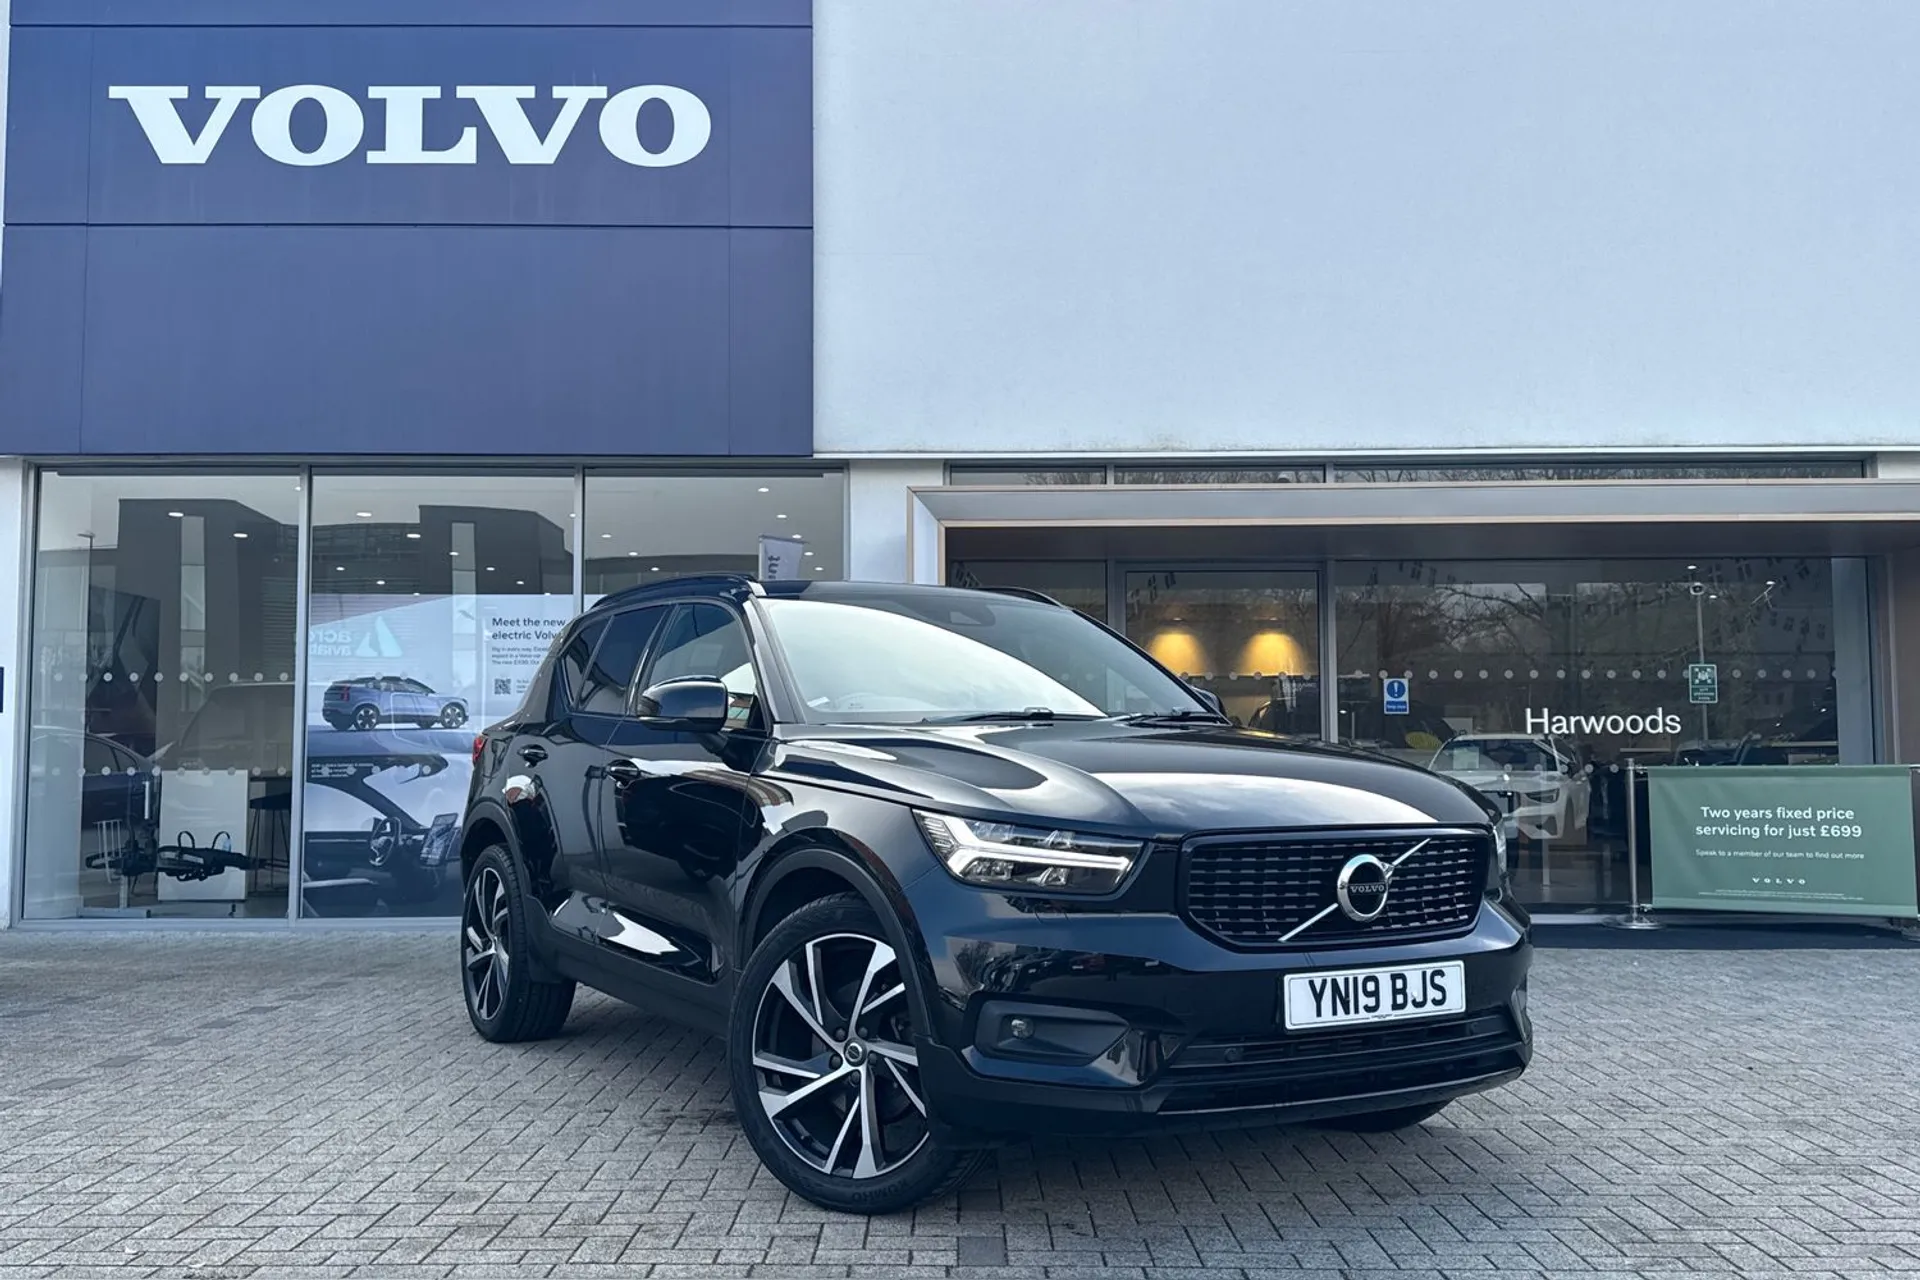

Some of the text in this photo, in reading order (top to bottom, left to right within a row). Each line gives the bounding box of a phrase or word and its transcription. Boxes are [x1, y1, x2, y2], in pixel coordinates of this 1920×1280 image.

[108, 84, 712, 168] VOLVO
[492, 617, 566, 627] Meet the new
[492, 630, 557, 640] electric Volv
[1525, 707, 1682, 734] Harwoods
[1700, 806, 1855, 822] Two years fixed price
[1695, 824, 1863, 839] servicing for just £699
[1696, 849, 1717, 857] Speak
[1752, 877, 1806, 885] VOLVO
[1350, 884, 1385, 893] VOLVO
[1308, 969, 1447, 1018] YN19 BJS
